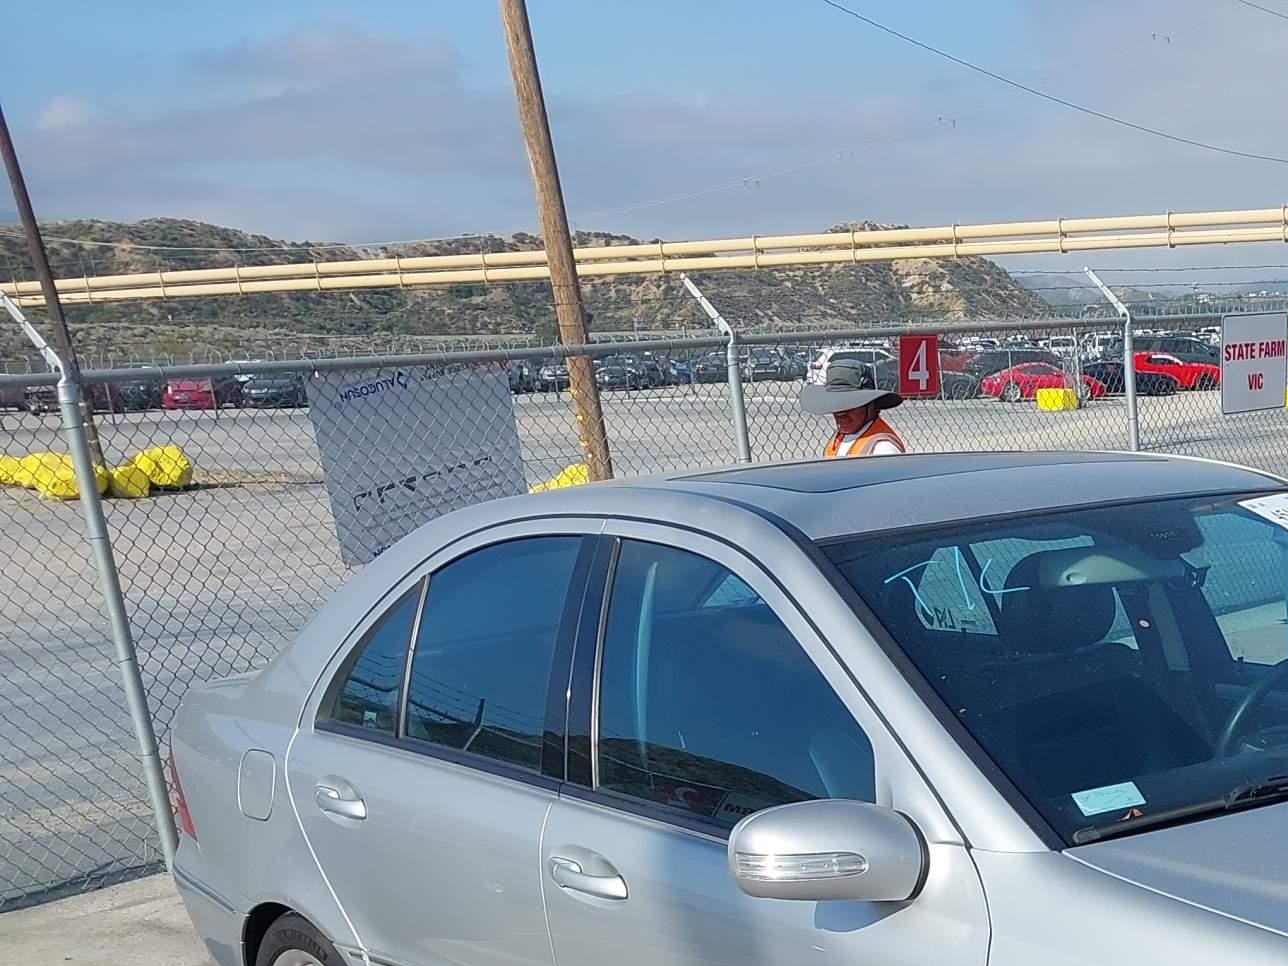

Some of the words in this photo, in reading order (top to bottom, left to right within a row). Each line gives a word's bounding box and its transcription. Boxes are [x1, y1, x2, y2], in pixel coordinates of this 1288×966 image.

[1224, 342, 1256, 362] STATE
[1258, 340, 1285, 358] FARM
[908, 340, 930, 390] 4
[1247, 372, 1264, 391] VIC
